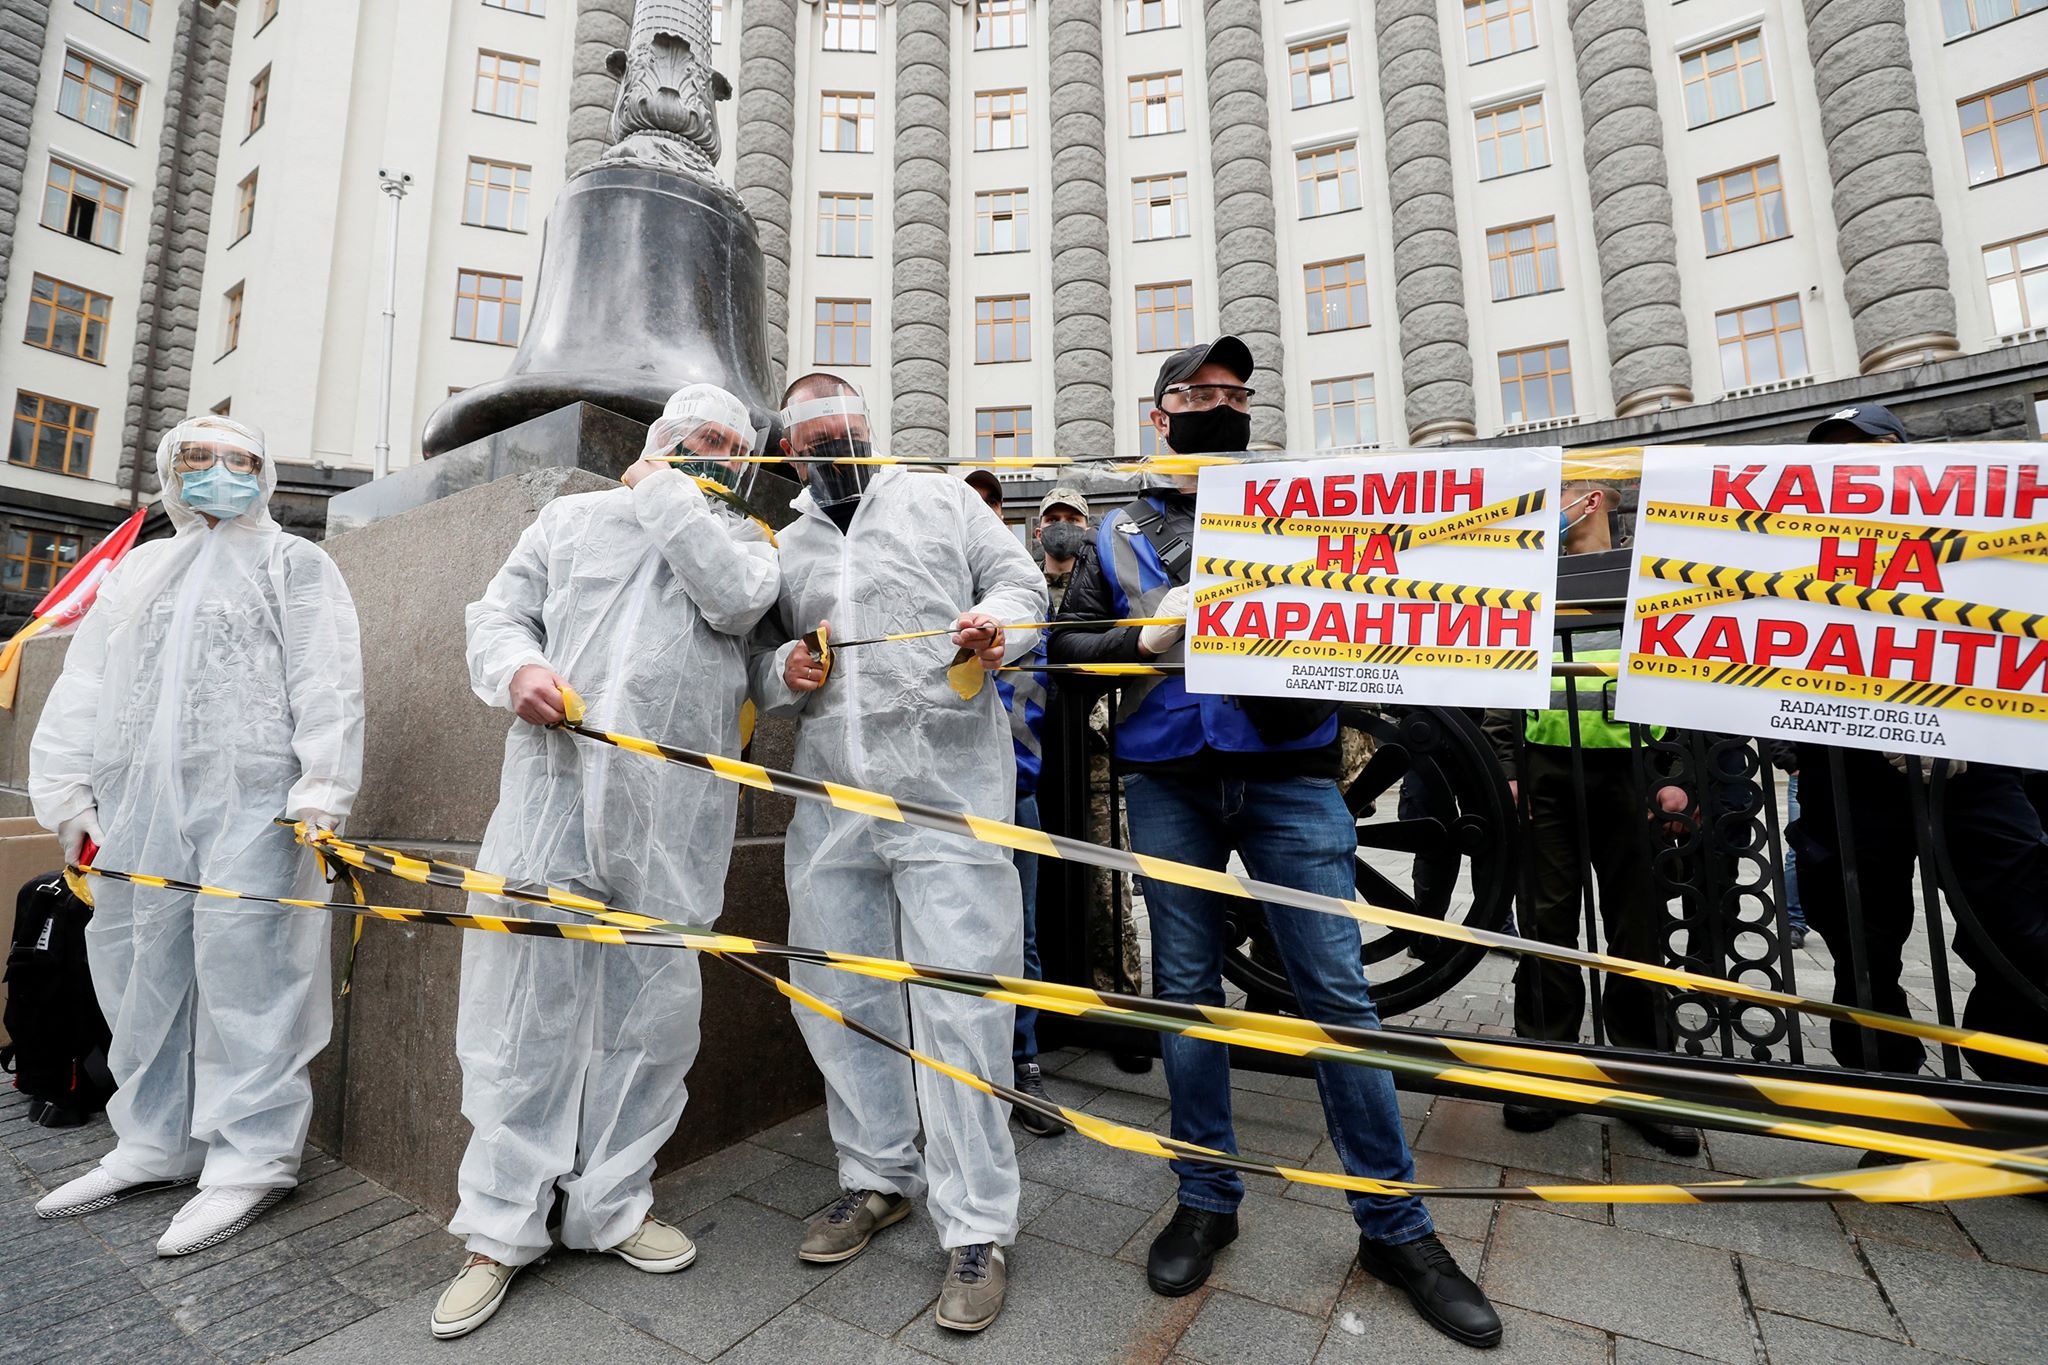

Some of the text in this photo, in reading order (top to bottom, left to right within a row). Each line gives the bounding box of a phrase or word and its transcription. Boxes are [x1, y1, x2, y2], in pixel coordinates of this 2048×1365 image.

[1243, 467, 1484, 518] КАБМІН
[1288, 523, 1376, 536] CORONAVIRUS
[1418, 507, 1509, 541] QUARANTINE
[1776, 520, 1911, 540] CORONAVIRUS
[1316, 533, 1399, 575] НА
[1817, 536, 1944, 593] НА
[1197, 600, 1533, 647] КАРАНТИН
[1292, 645, 1362, 659] COVID-19
[1415, 653, 1492, 665] COVID-19
[1292, 664, 1400, 680] RADAMIST.ORG.UA
[1285, 678, 1404, 695] GARANT-BIZ.ORG.UA
[1781, 675, 1884, 696] COVID-19
[1779, 699, 1940, 727] RADAMIST.ORG.UA
[1770, 715, 1947, 746] GARANT-BIZ.ORG.UA
